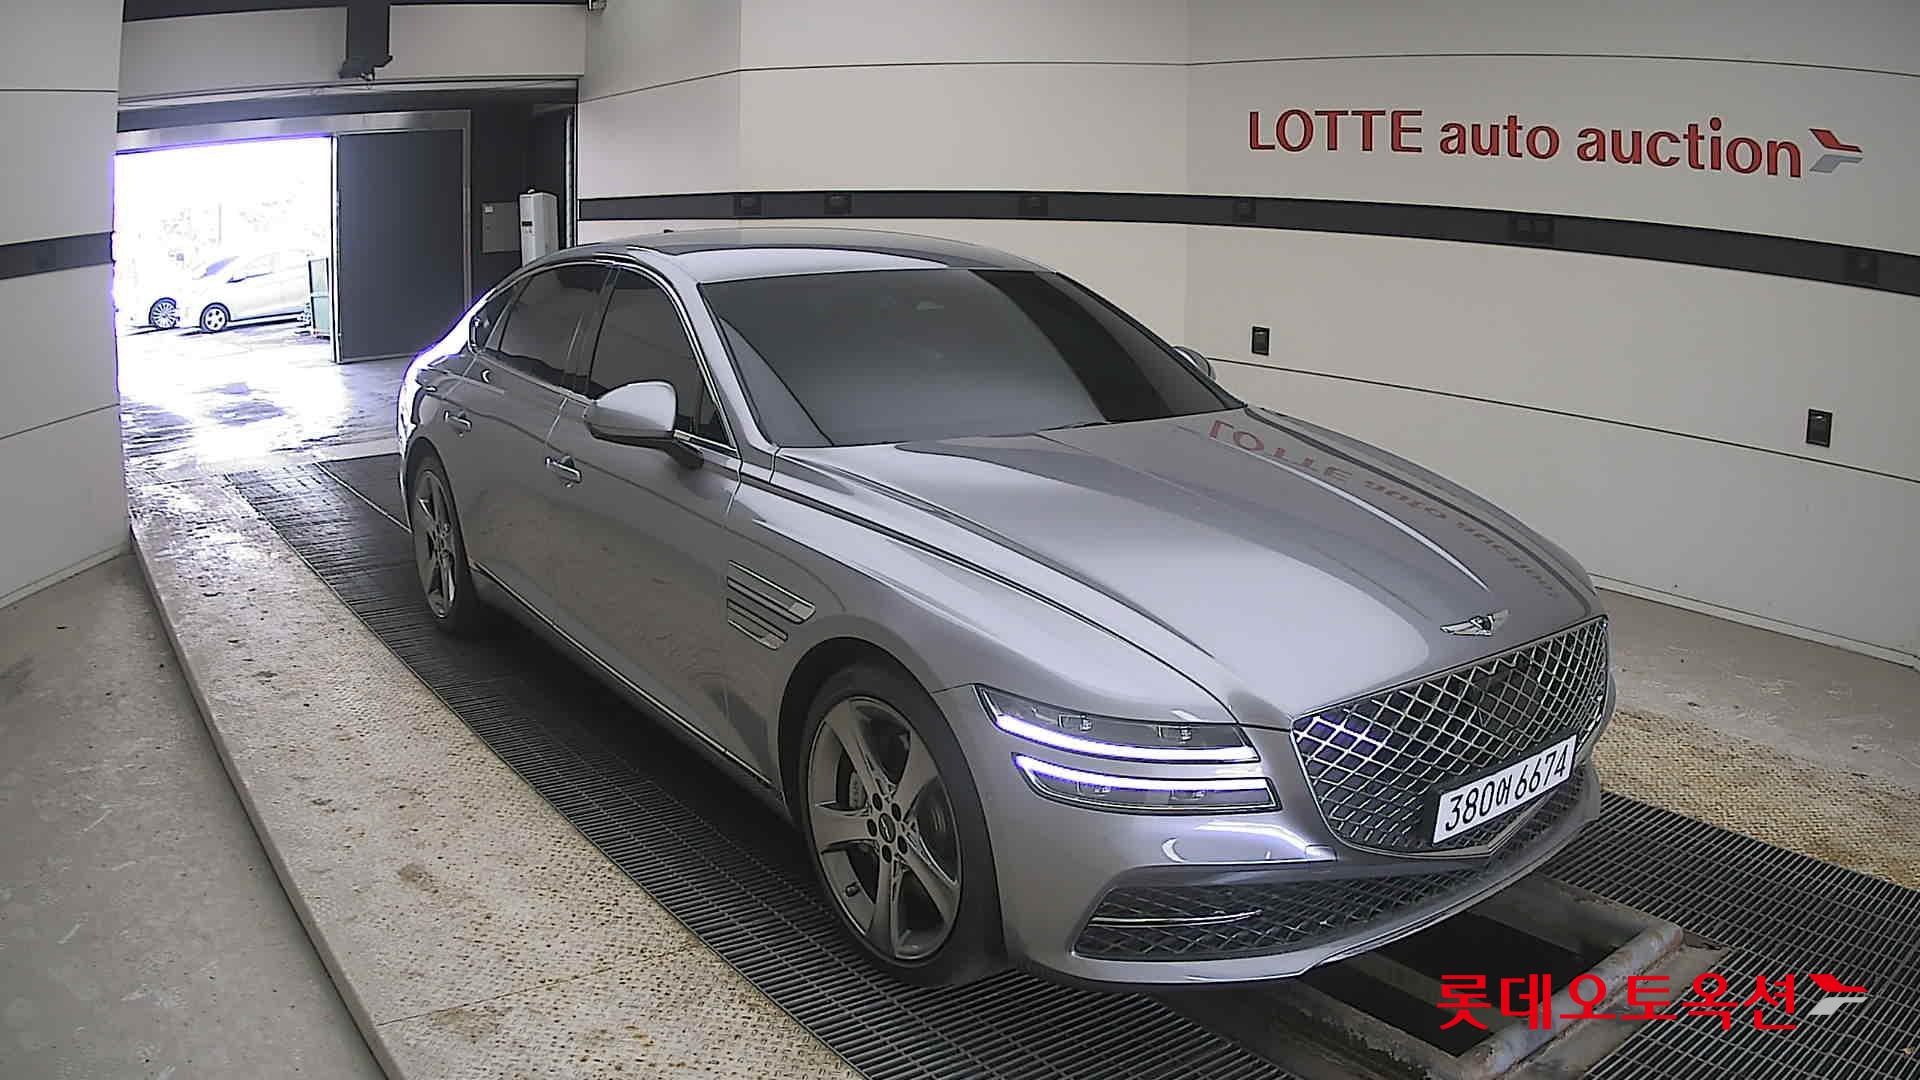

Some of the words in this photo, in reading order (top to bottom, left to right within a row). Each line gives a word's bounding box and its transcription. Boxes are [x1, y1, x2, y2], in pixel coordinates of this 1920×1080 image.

[1249, 111, 1423, 152] LOTTE
[1440, 116, 1560, 159] auto
[1577, 117, 1802, 178] auction
[1445, 774, 1513, 832] 380어
[1514, 744, 1570, 801] 6674
